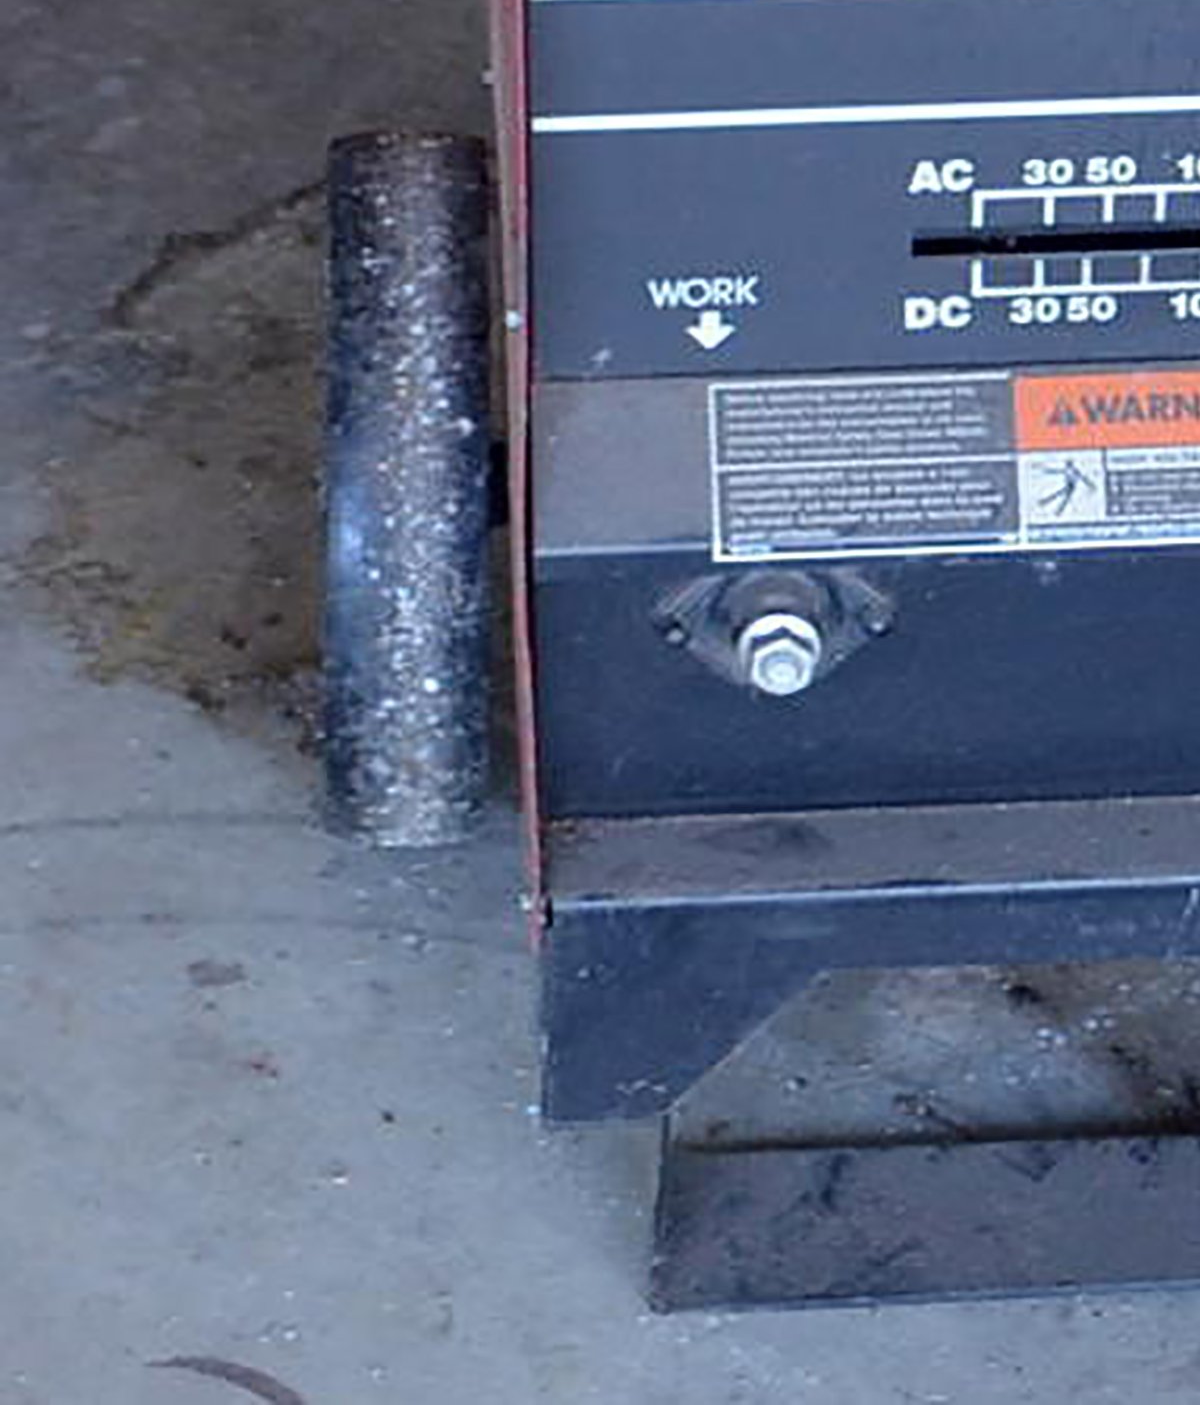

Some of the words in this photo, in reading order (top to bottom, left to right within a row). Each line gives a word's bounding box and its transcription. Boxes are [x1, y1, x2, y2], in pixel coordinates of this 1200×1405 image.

[909, 159, 974, 193] AC
[1023, 160, 1073, 185] 30
[1086, 156, 1136, 183] 50
[647, 275, 760, 309] WORK
[904, 296, 972, 329] DC
[1009, 298, 1060, 324] 30
[1067, 296, 1117, 321] 50
